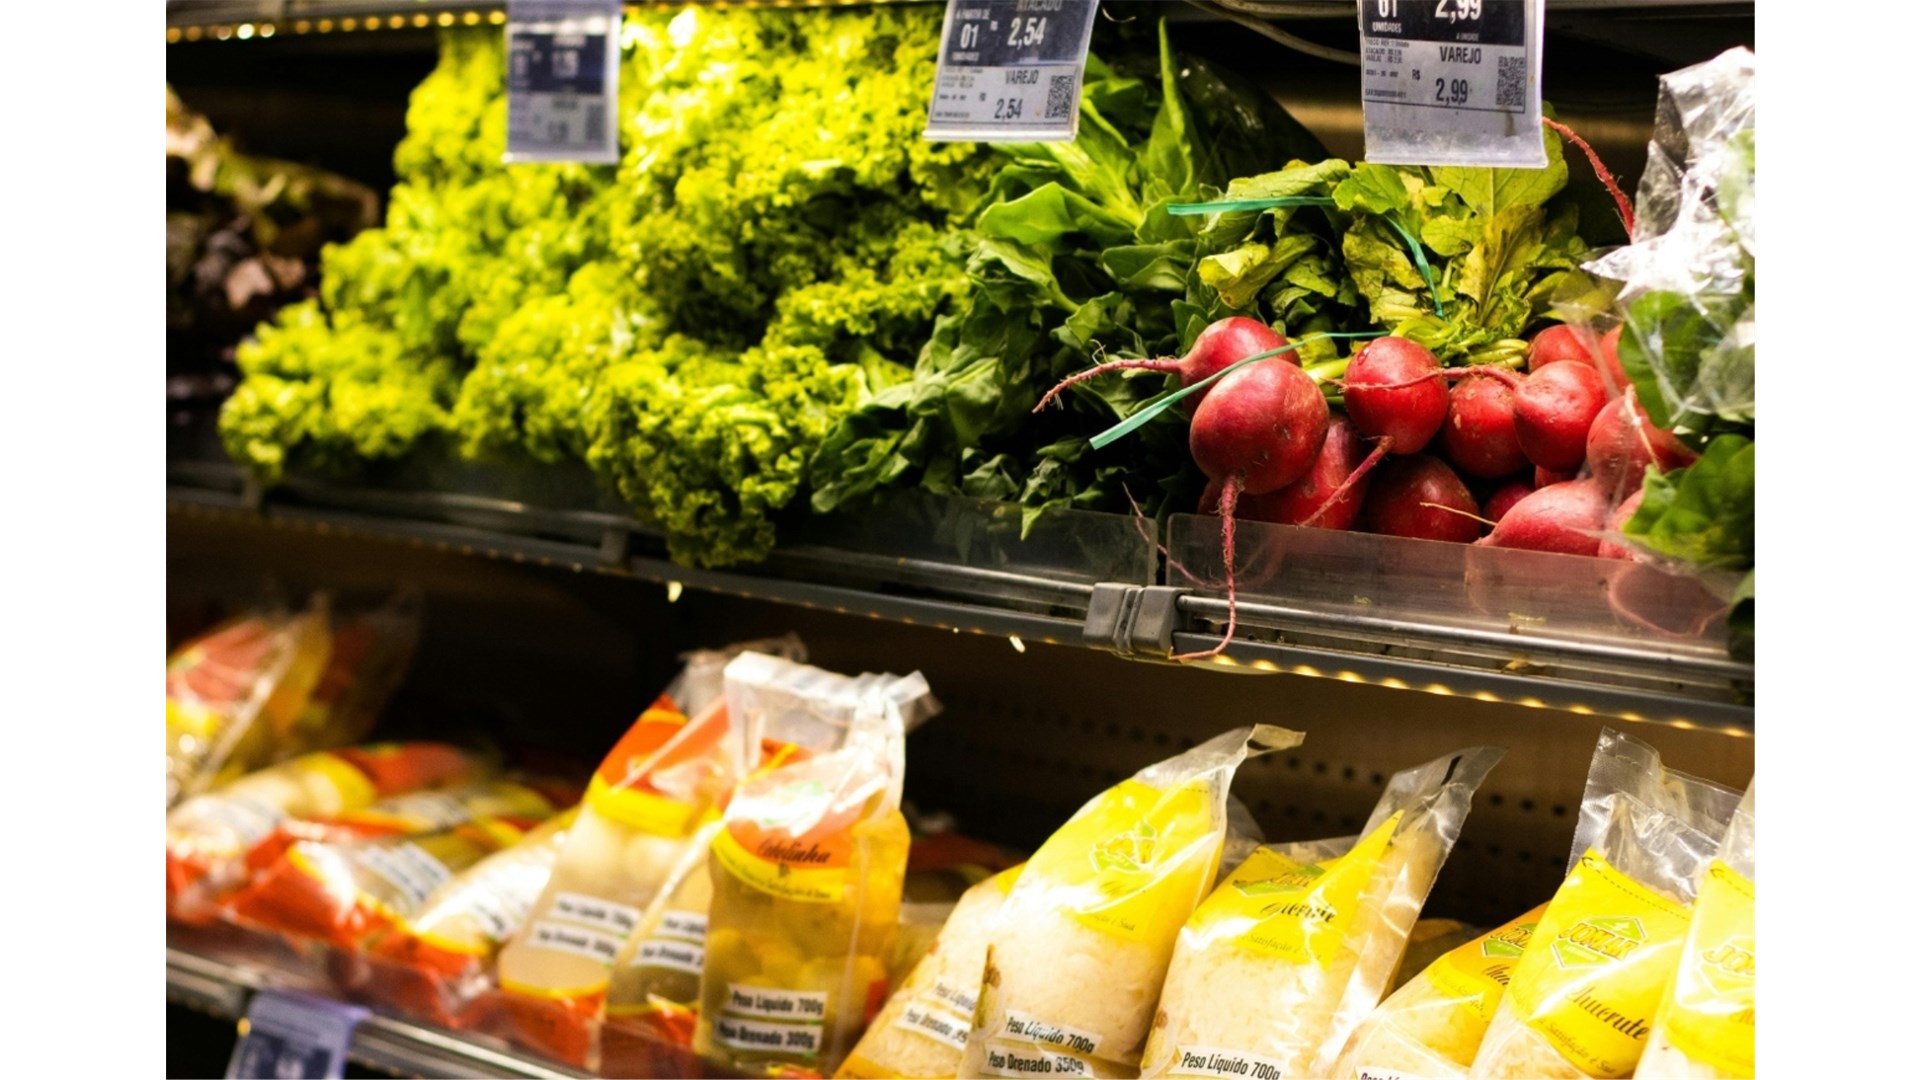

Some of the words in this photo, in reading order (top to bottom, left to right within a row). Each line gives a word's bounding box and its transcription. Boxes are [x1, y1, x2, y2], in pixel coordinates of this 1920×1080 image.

[1434, 0, 1483, 24] 2,99
[959, 23, 980, 49] 01
[1006, 16, 1047, 49] 2,54
[1440, 46, 1482, 64] VAREJO
[1005, 69, 1039, 85] VAREJO
[1411, 69, 1421, 81] R$
[1435, 78, 1469, 105] 2,99
[993, 98, 1023, 120] 2,54
[756, 993, 794, 1013] Líquido
[797, 997, 824, 1016] 700g
[739, 1025, 783, 1046] Drenado
[952, 1028, 969, 1044] 35
[1006, 1016, 1024, 1035] Peso
[1024, 1021, 1065, 1045] Líquido
[1065, 1034, 1096, 1055] 700g
[988, 1050, 1006, 1069] Peso
[1007, 1053, 1052, 1074] Drenado
[1054, 1056, 1085, 1075] 350g
[1181, 1052, 1206, 1069] Peso
[1206, 1054, 1249, 1076] Líquido
[1252, 1060, 1281, 1079] 700g
